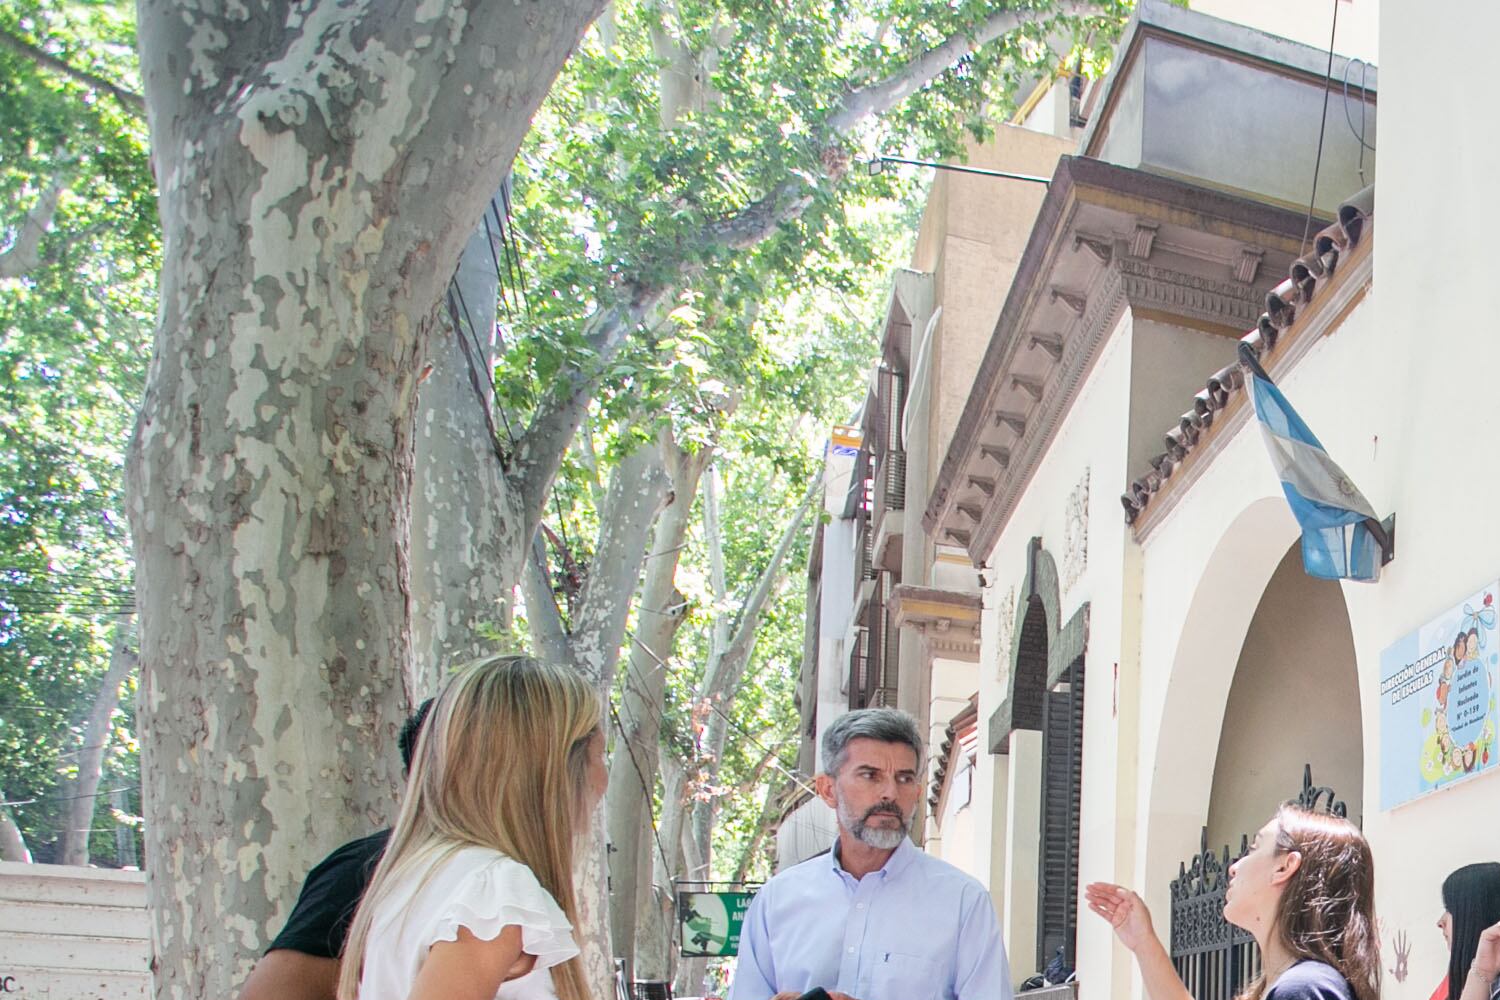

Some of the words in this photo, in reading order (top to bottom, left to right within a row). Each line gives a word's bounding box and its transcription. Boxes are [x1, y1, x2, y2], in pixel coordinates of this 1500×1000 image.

[1381, 664, 1414, 696] DIRECCIÓN
[1415, 646, 1446, 675] GENERAL
[1392, 688, 1401, 705] DE
[1402, 670, 1433, 700] ESCUELAS
